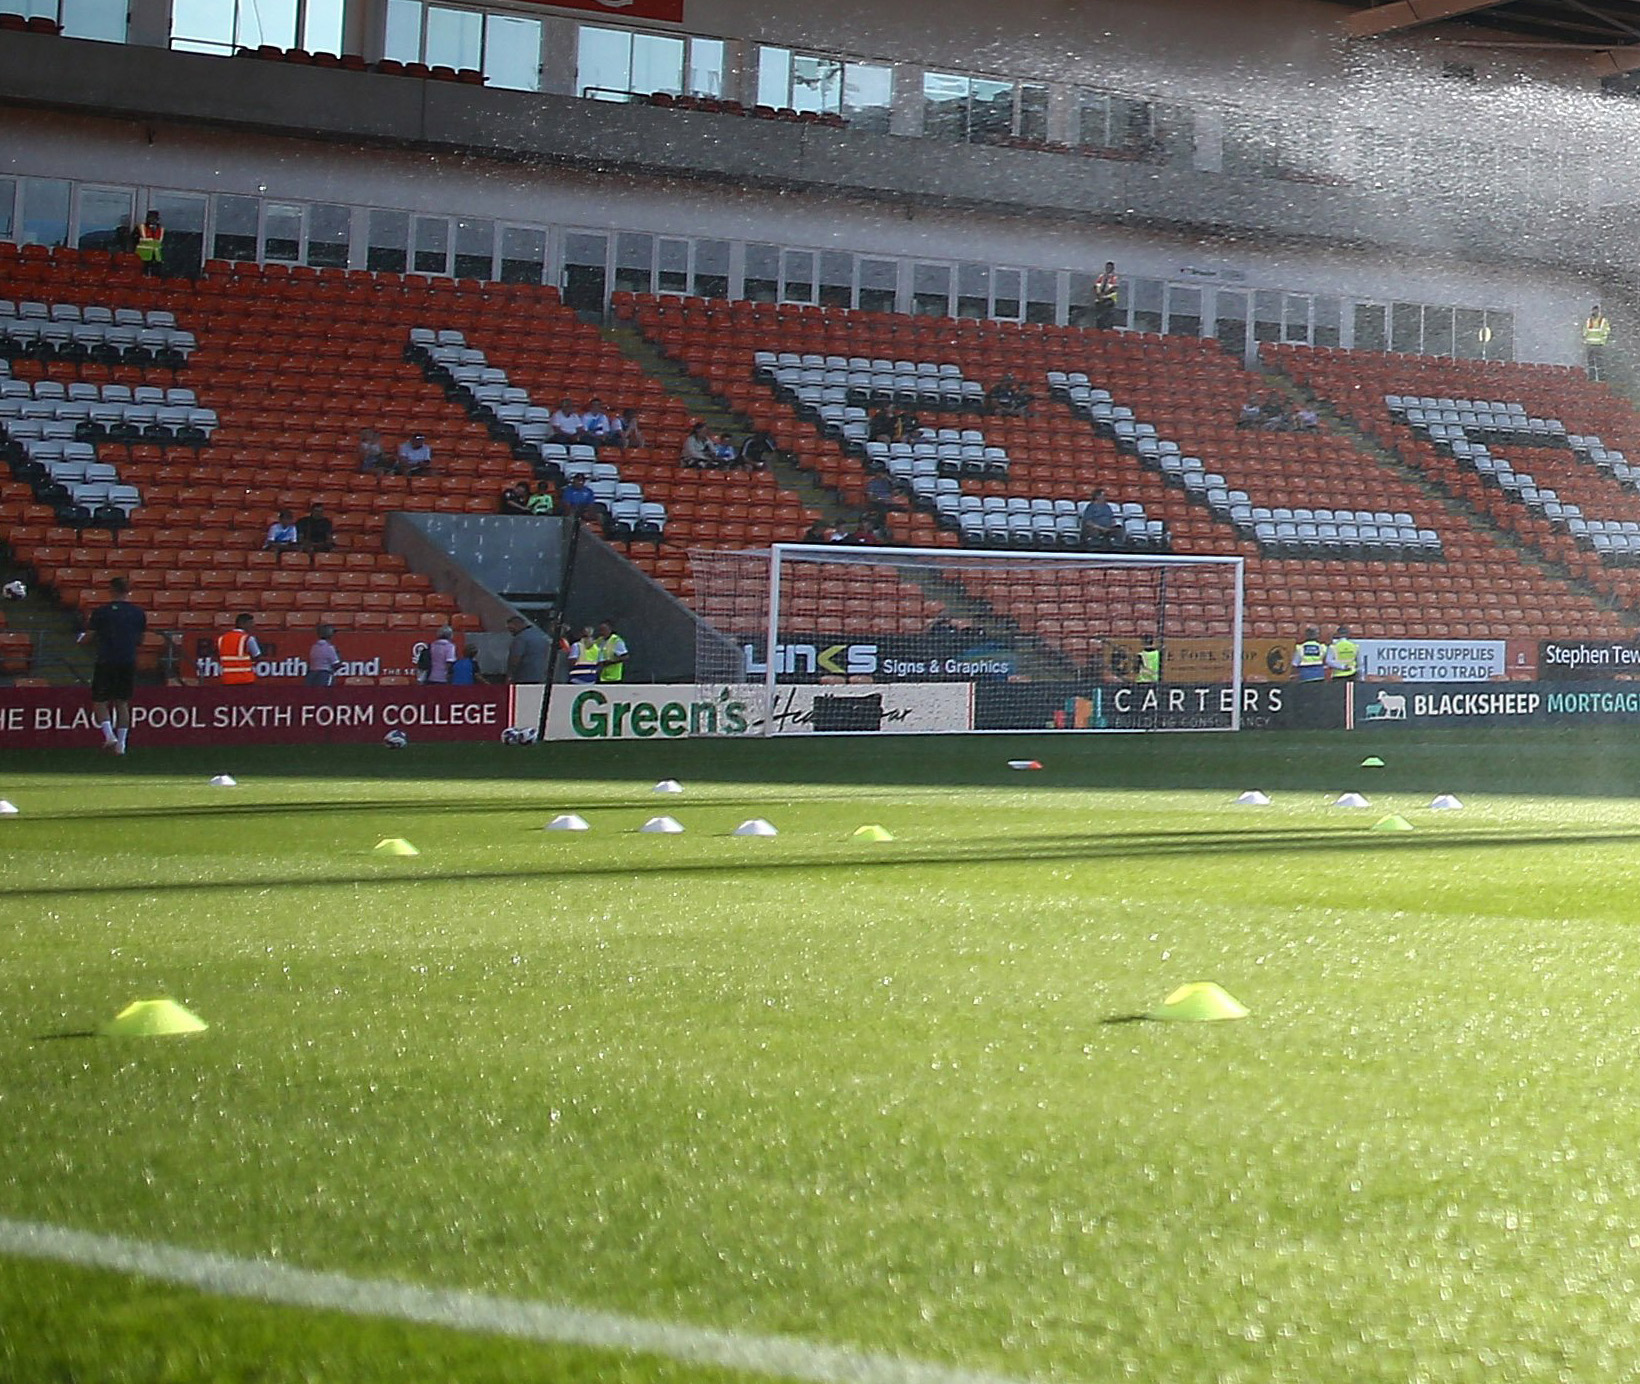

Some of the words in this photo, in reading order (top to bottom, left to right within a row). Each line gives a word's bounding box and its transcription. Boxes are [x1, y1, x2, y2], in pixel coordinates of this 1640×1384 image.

[1377, 647, 1436, 661] KITCHEN
[1438, 647, 1495, 661] SUPPLIES
[1546, 645, 1609, 668] Stephen
[883, 659, 925, 677] Signs
[929, 659, 940, 673] &
[945, 658, 1009, 677] Graphics
[1429, 666, 1446, 679] TO
[1114, 688, 1284, 713] CARTERS
[1414, 692, 1541, 716] BLACKSHEEP
[213, 705, 292, 727] SIXTH
[301, 704, 374, 726] FORM
[382, 703, 497, 725] COLLEGE
[571, 687, 749, 738] Green's
